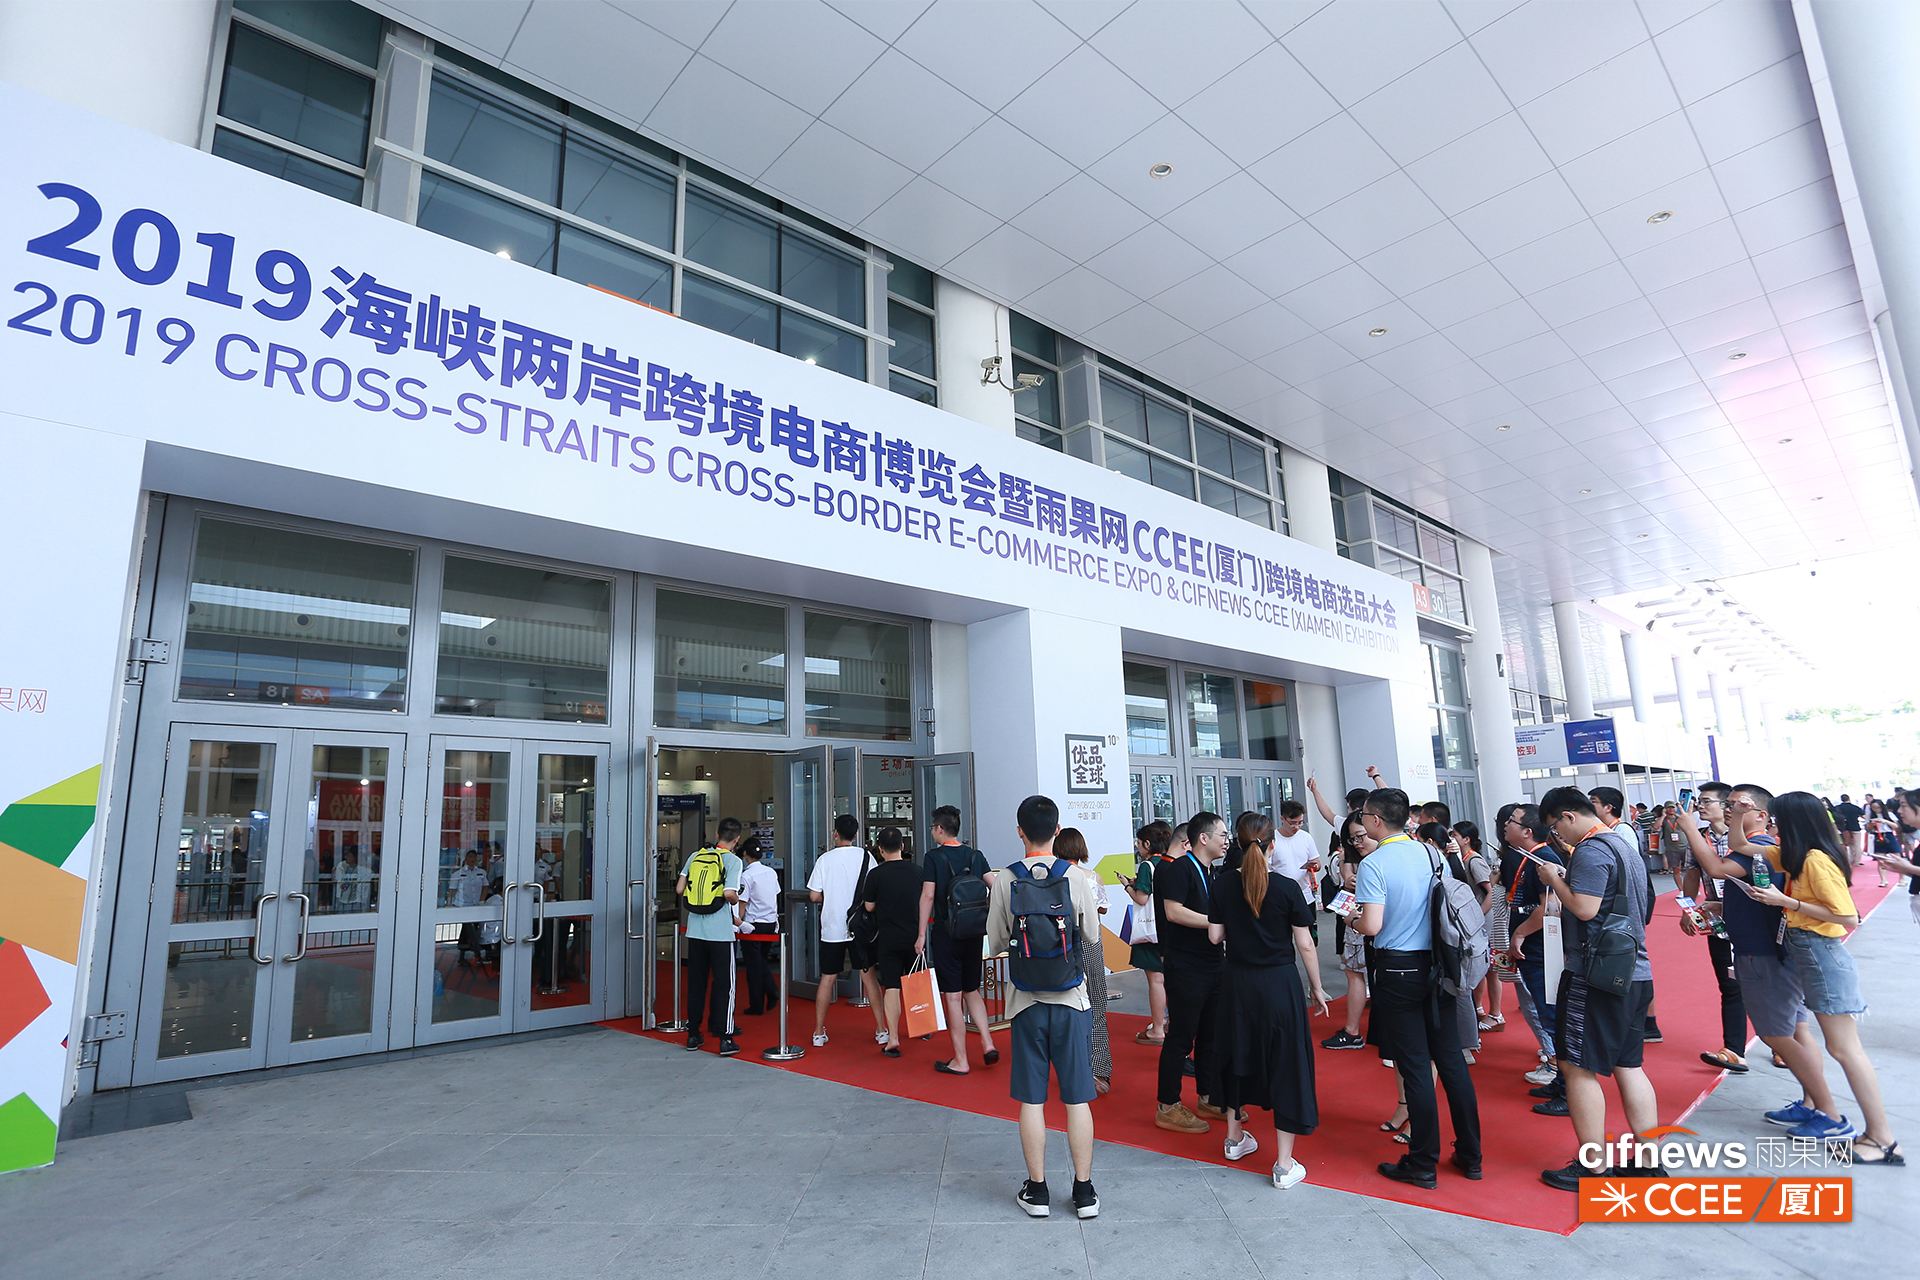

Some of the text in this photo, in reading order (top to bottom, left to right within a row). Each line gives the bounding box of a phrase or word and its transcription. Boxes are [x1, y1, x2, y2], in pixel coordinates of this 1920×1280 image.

[6, 281, 195, 364] 2019
[214, 333, 656, 474] CROSS-STRAITS
[667, 446, 942, 543] CROSS-BORDER
[949, 517, 1110, 584] E-COMMERCE
[1114, 561, 1162, 597] EXPO
[1167, 576, 1179, 601] &
[1181, 580, 1251, 618] CIFNEWS
[1254, 600, 1289, 628] CCEE
[1344, 624, 1400, 654] EXHIBITION
[1415, 588, 1428, 608] A3
[1071, 744, 1104, 765] 优品
[1072, 764, 1104, 785] 全球
